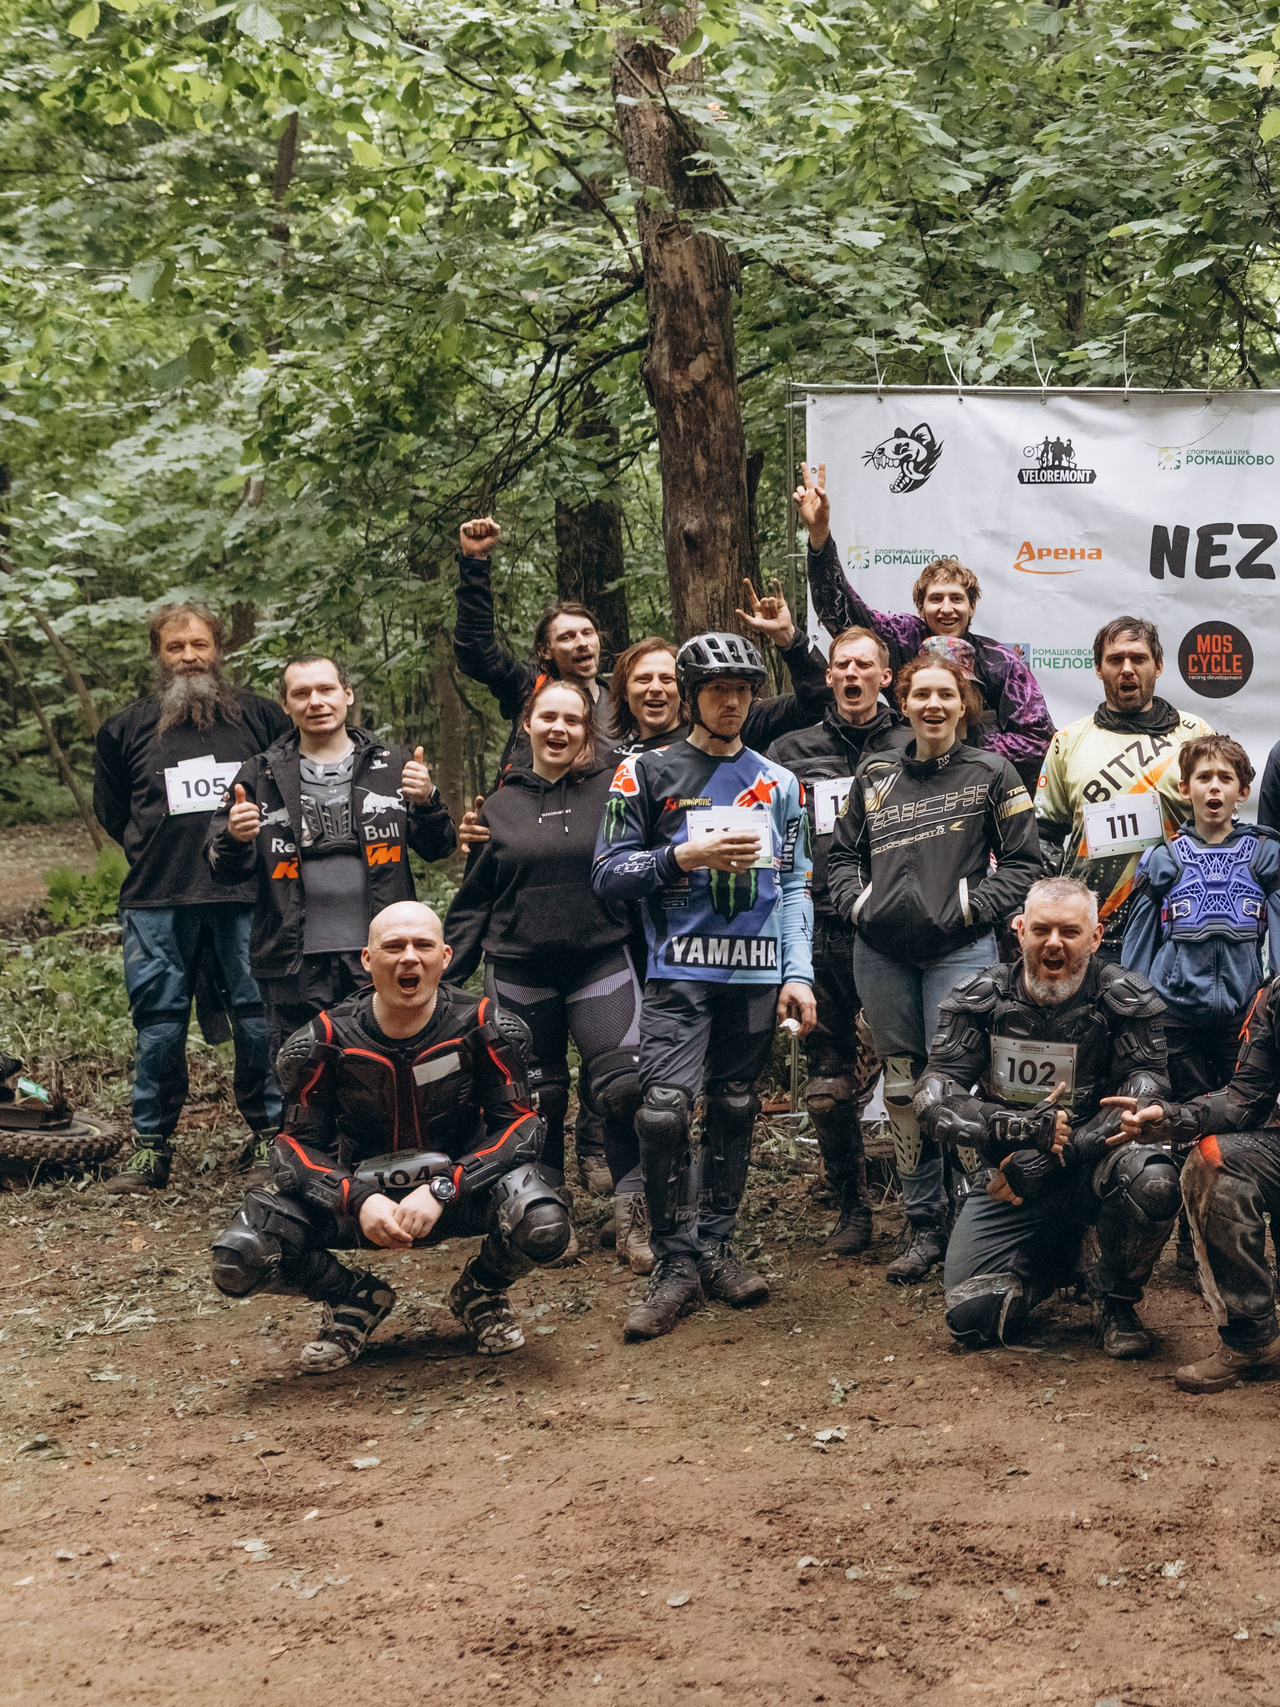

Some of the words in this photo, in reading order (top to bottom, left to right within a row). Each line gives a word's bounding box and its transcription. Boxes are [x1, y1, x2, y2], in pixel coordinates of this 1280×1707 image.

[1186, 455, 1275, 466] РОМАШКОВО
[1021, 469, 1092, 483] VELOREMONT
[1015, 541, 1102, 561] Арена
[1032, 648, 1094, 656] РОМАШКОВСК
[1196, 634, 1233, 654] MOS
[1032, 657, 1094, 669] ПЧЕЛОВ
[1188, 654, 1243, 673] CYCLE
[1082, 733, 1173, 804] BITZA
[181, 777, 229, 799] 105
[1106, 813, 1139, 839] 111
[271, 837, 297, 854] Re
[364, 822, 401, 841] Bull
[671, 935, 778, 967] YAMAHA
[1007, 1056, 1056, 1087] 102
[373, 1165, 431, 1188] 104
